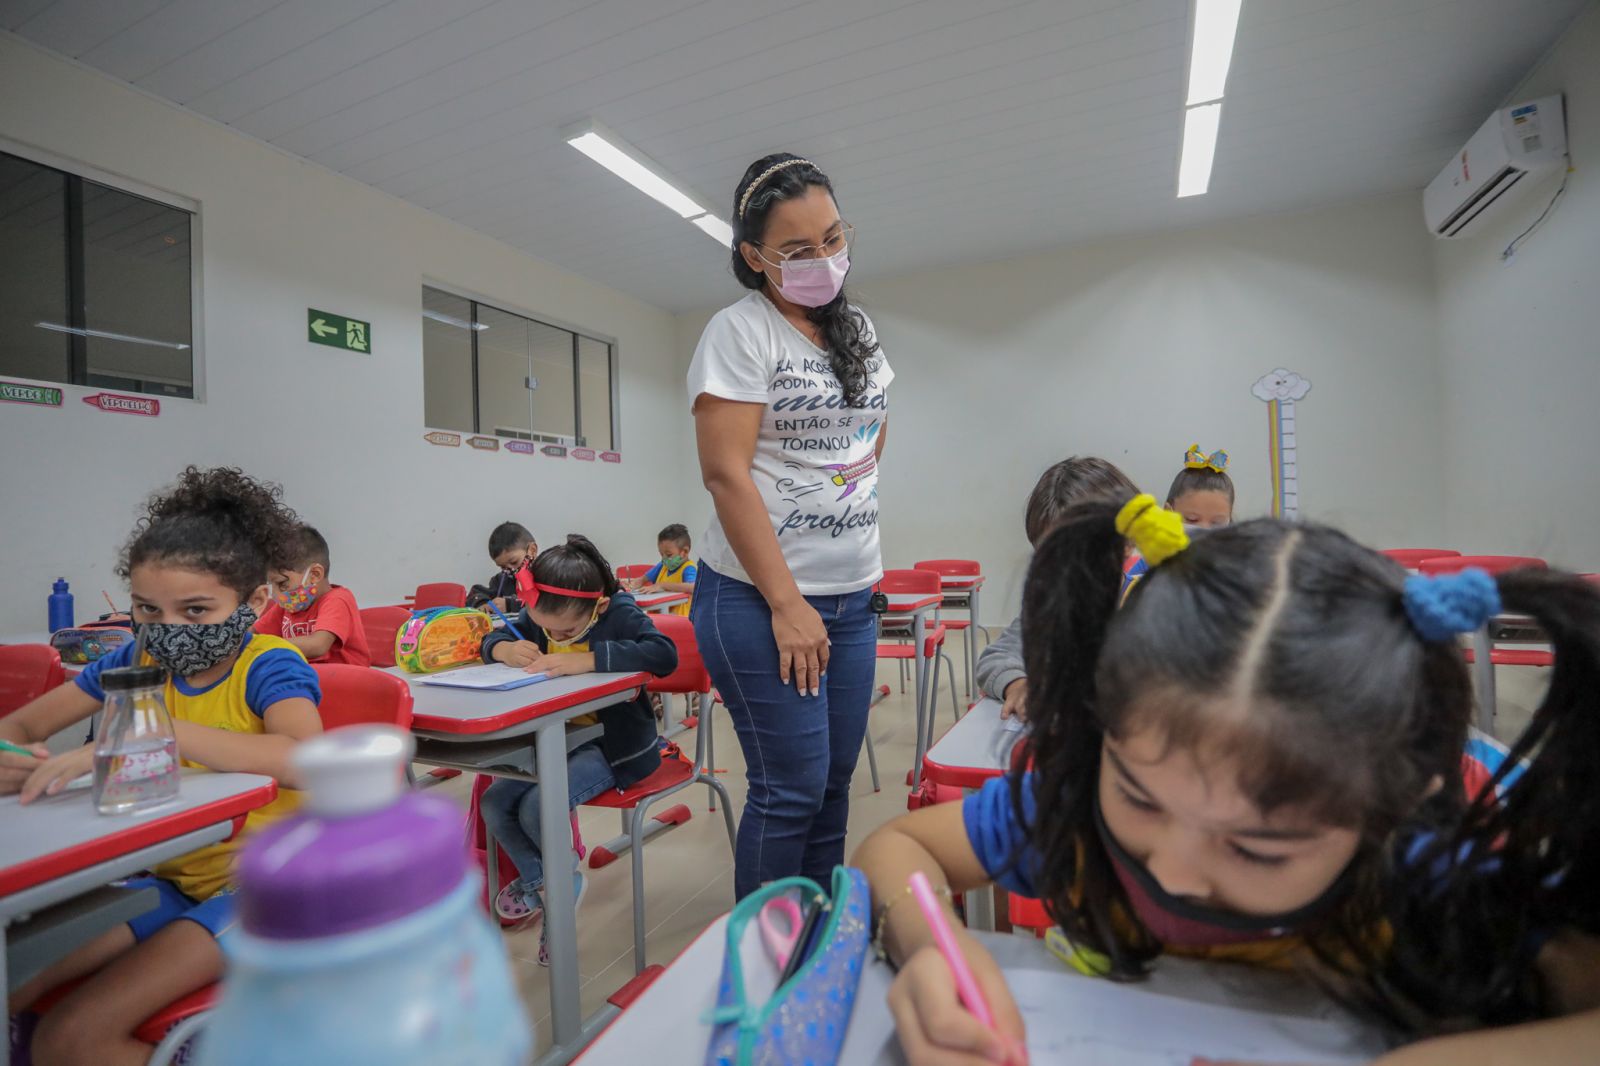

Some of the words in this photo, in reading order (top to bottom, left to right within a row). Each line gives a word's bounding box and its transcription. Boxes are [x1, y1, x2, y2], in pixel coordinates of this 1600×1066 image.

[773, 378, 818, 391] PODIA
[4, 387, 40, 400] VERDE
[775, 416, 831, 431] ENTÃO
[838, 416, 853, 428] SE
[779, 436, 851, 451] TORNOU
